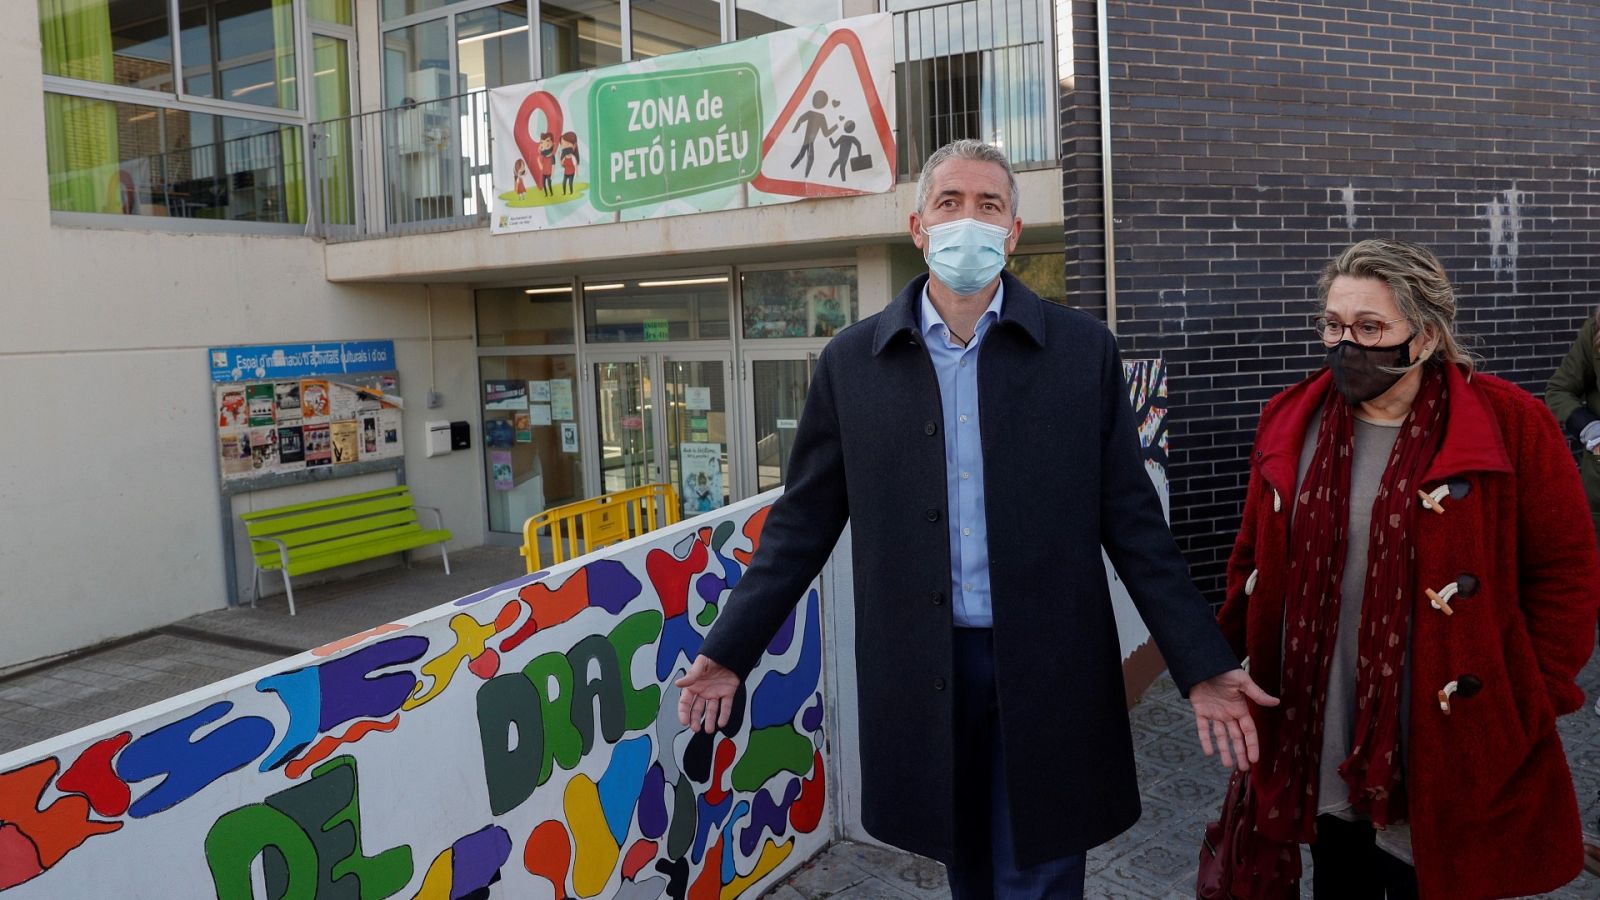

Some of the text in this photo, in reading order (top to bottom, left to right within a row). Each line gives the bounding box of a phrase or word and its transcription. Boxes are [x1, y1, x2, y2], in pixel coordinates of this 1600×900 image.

[627, 89, 723, 132] ZONA de
[611, 123, 749, 183] PETÓ i ADÉU
[236, 354, 259, 373] Espai
[475, 609, 664, 817] DRAC
[204, 754, 414, 900] DEL
